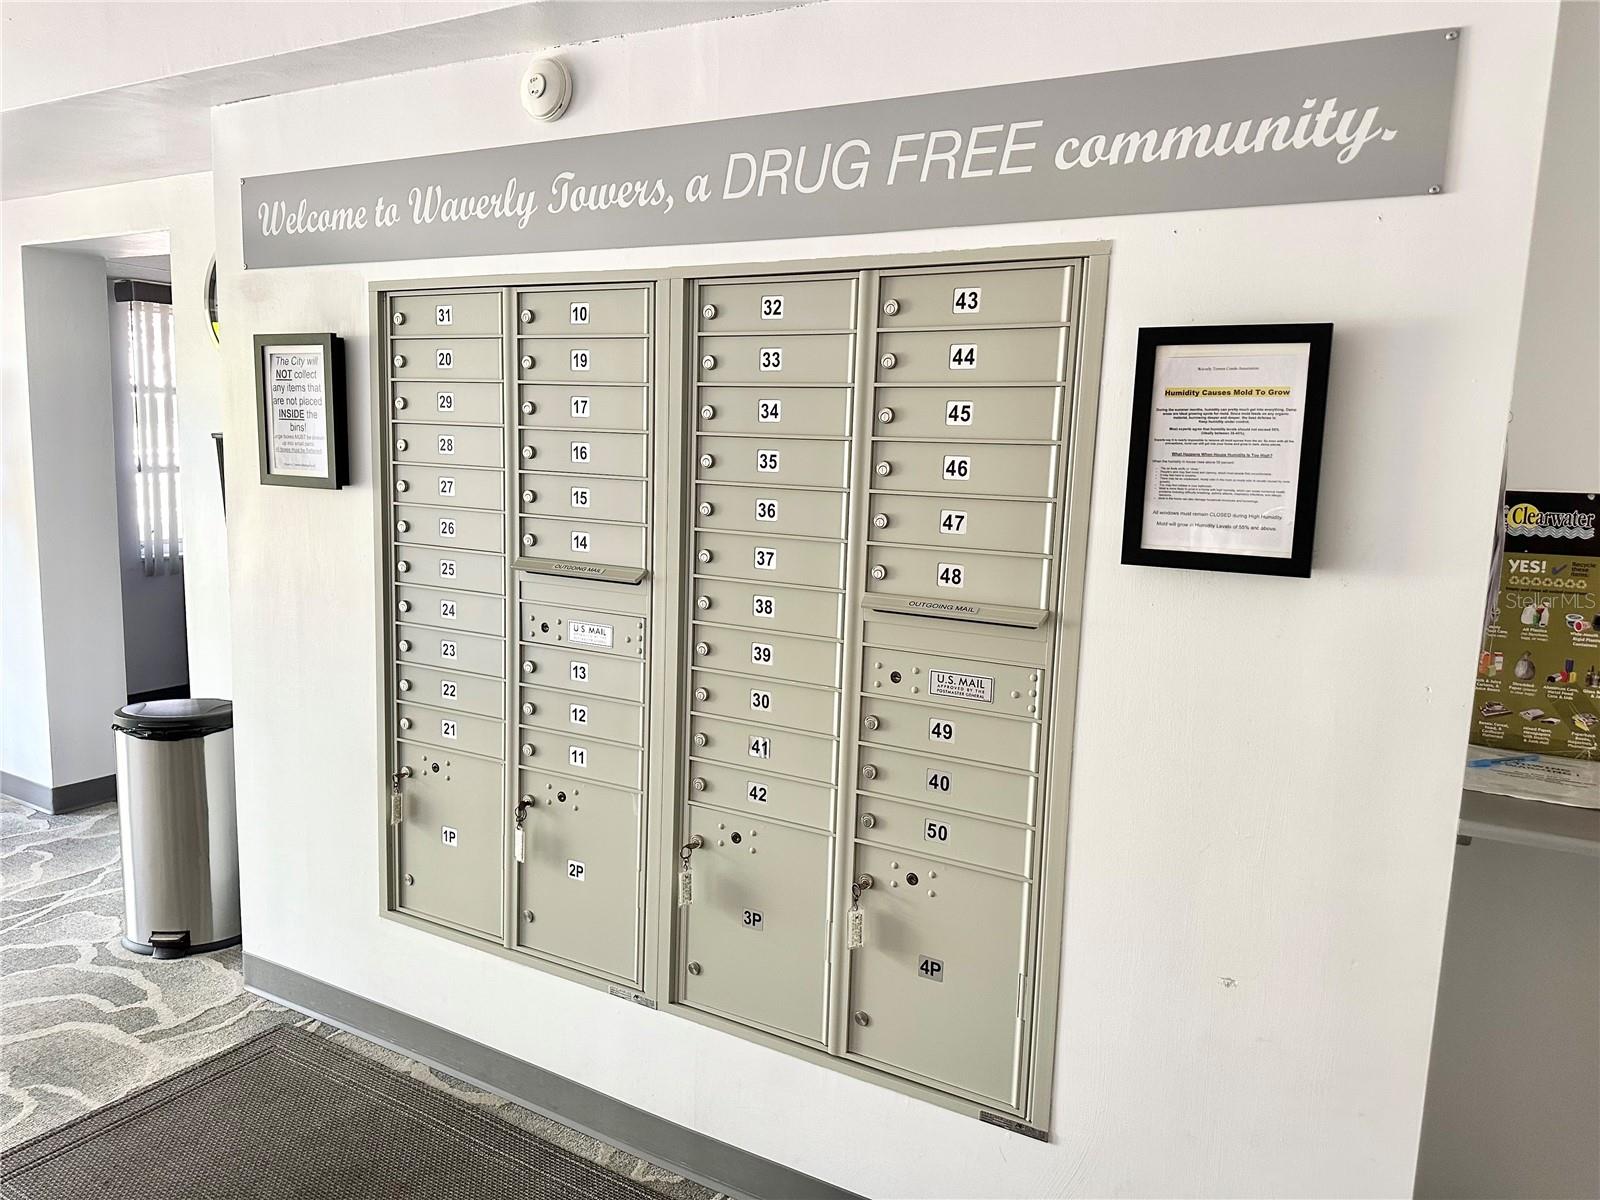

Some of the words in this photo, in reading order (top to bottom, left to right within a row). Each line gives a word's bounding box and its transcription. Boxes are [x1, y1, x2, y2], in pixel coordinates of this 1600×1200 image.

[258, 198, 368, 235] Welcome
[374, 196, 401, 228] to
[408, 177, 539, 230] Waverly
[547, 171, 674, 215] Towers,
[685, 174, 712, 203] a
[722, 139, 871, 200] DRUG
[886, 120, 1044, 186] FREE
[1054, 97, 1398, 170] community.
[763, 299, 782, 316] 32
[955, 291, 978, 310] 43
[438, 308, 450, 322] 31
[572, 306, 587, 321] 10
[276, 356, 289, 366] The
[291, 356, 304, 368] City
[306, 356, 318, 365] will
[438, 352, 452, 366] 20
[573, 353, 588, 368] 19
[762, 351, 781, 368] 33
[952, 347, 975, 366] 44
[276, 370, 292, 379] NOT
[294, 370, 317, 379] collect
[272, 384, 286, 394] any
[286, 383, 306, 392] items
[307, 384, 321, 392] that
[273, 398, 284, 406] are
[286, 398, 298, 406] not
[299, 396, 322, 408] placed
[439, 395, 452, 408] 29
[573, 399, 588, 414] 17
[278, 408, 304, 420] INSIDE
[306, 410, 318, 419] the
[761, 403, 779, 419] 34
[948, 404, 971, 422] 45
[290, 423, 306, 432] bins!
[440, 438, 453, 452] 28
[573, 446, 587, 460] 16
[759, 453, 777, 470] 35
[945, 459, 968, 477] 46
[440, 480, 453, 493] 27
[573, 490, 588, 505] 15
[758, 502, 776, 519] 36
[1512, 506, 1595, 528] Clearwater
[441, 522, 454, 535] 26
[942, 514, 965, 531] 47
[573, 535, 588, 549] 14
[756, 550, 775, 567] 37
[1508, 558, 1547, 574] YES!
[441, 562, 455, 576] 25
[554, 564, 587, 572] OUTGOING
[939, 567, 962, 585] 48
[442, 603, 455, 616] 24
[755, 598, 773, 615] 38
[908, 600, 954, 610] OUTGOING
[589, 628, 606, 636] MAIL
[442, 643, 456, 657] 23
[753, 646, 771, 663] 39
[572, 665, 586, 680] 13
[937, 674, 956, 685] U.S.
[958, 678, 984, 689] MAIL
[443, 683, 456, 697] 22
[752, 692, 770, 709] 30
[572, 708, 586, 723] 12
[443, 722, 455, 736] 21
[931, 722, 953, 740] 49
[751, 739, 768, 756] 41
[571, 750, 584, 764] 11
[928, 773, 950, 792] 40
[749, 785, 767, 802] 42
[443, 830, 456, 843] 1P
[927, 822, 948, 842] 50
[569, 863, 584, 878] 2P
[743, 910, 762, 927] 3P
[919, 959, 942, 977] 4P
